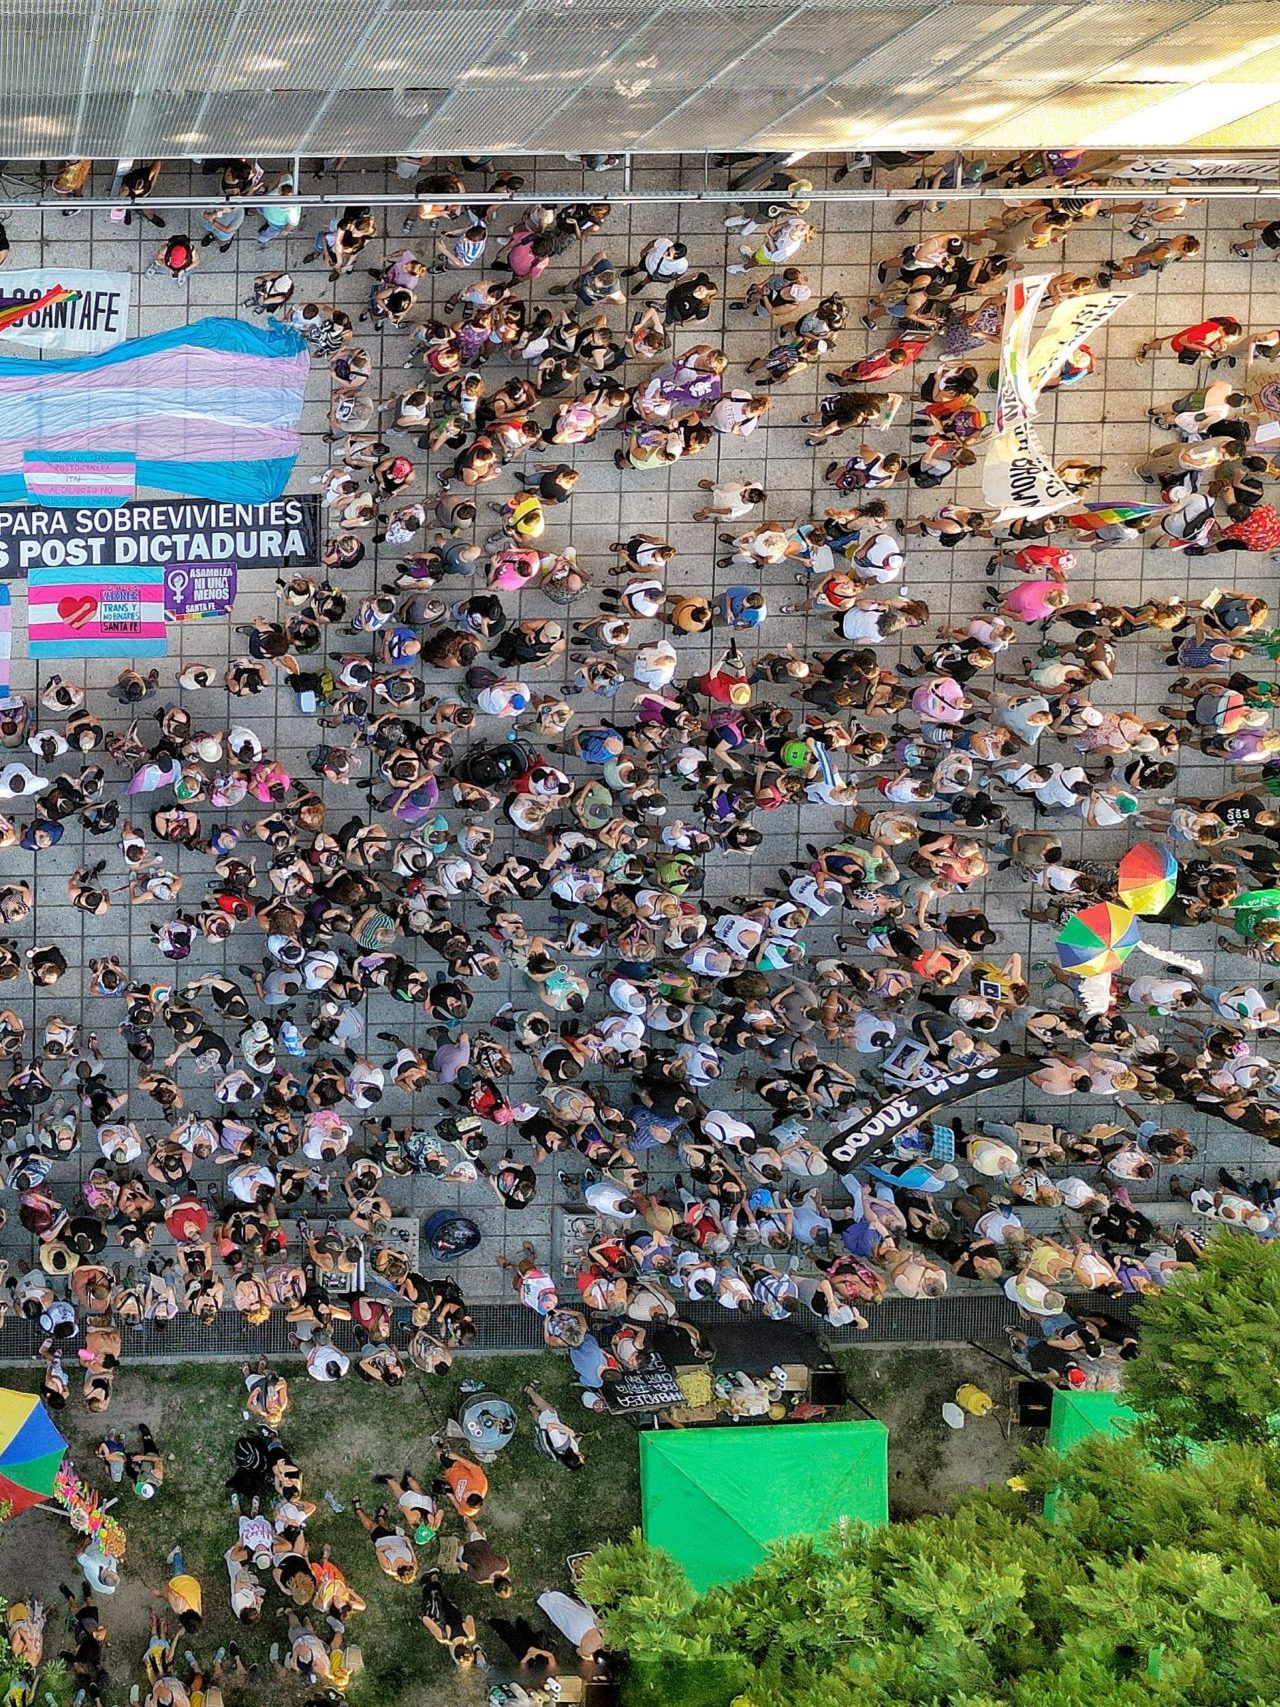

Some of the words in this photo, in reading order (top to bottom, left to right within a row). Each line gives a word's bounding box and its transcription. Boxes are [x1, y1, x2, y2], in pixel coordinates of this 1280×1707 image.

[75, 500, 303, 534] SOBREVIVIENTES
[20, 537, 106, 567] POST
[115, 529, 306, 565] DICTADURA
[189, 567, 233, 578] ASAMBLEA
[194, 577, 206, 590] NI
[207, 576, 229, 589] UNA
[193, 588, 230, 601] MENOS
[103, 603, 129, 612] TRANS
[131, 603, 138, 611] Y
[185, 603, 207, 613] SANTA
[207, 602, 216, 610] FE
[103, 621, 128, 631] SANTA
[130, 621, 138, 631] FE
[831, 1097, 919, 1162] 30000
